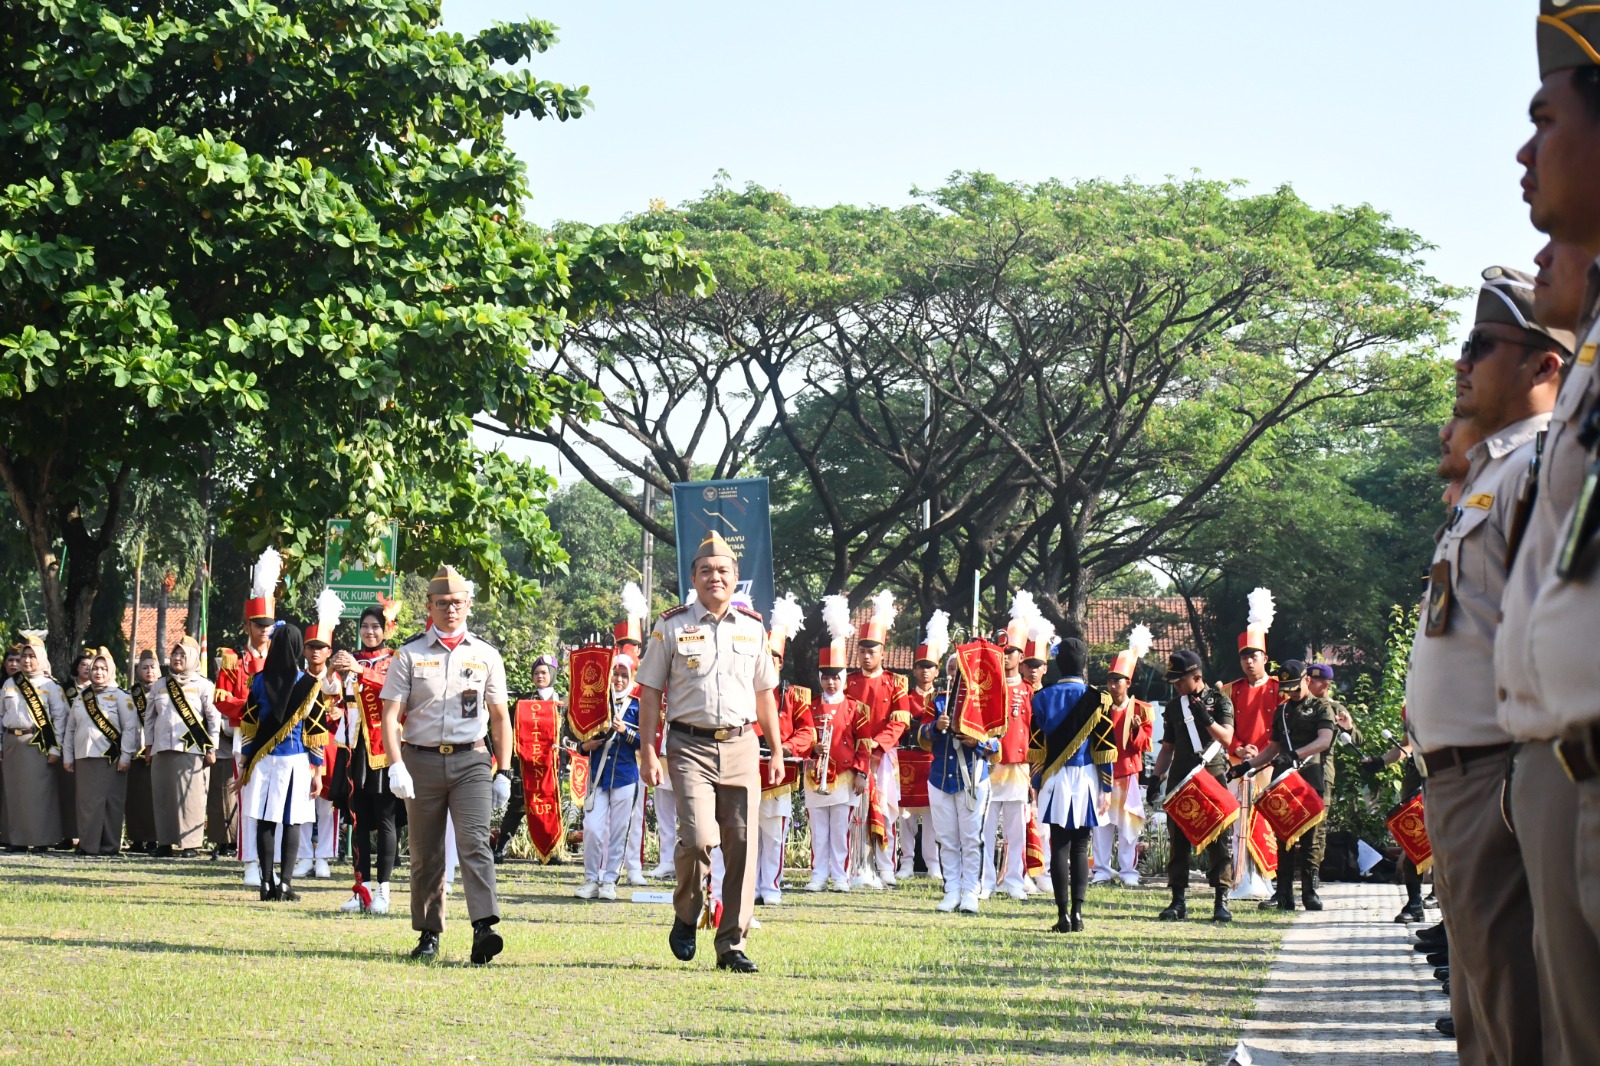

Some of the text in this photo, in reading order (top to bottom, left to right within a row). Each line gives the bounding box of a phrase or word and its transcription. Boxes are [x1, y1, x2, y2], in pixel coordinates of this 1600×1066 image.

[335, 590, 383, 601] TIK KUMP
[343, 606, 363, 615] embly
[29, 695, 47, 727] BARANTIN
[174, 697, 196, 726] BARANTIN
[363, 685, 382, 729] YORET
[94, 714, 118, 740] BARANTIN
[530, 703, 545, 803] OLITEKNIK
